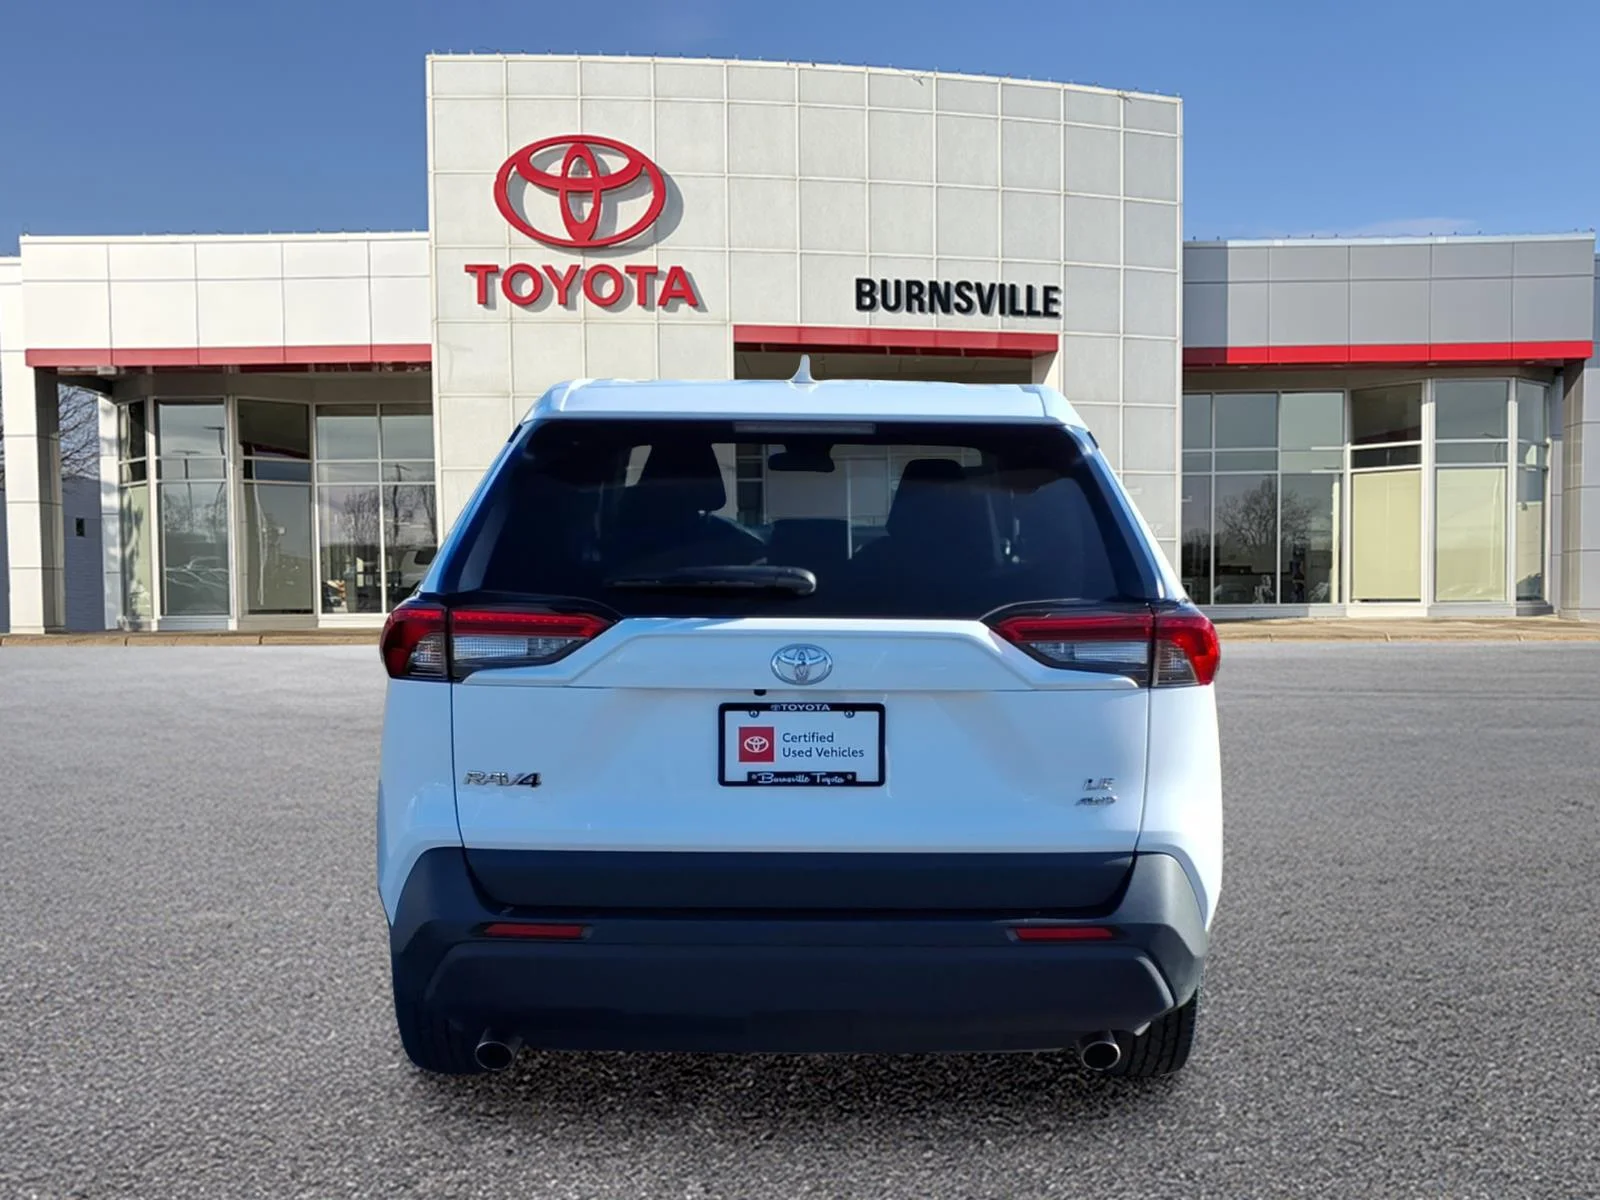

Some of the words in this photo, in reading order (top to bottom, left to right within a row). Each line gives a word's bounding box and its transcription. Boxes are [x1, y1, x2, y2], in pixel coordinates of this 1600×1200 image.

[464, 263, 699, 308] TOYOTA
[855, 277, 1062, 318] BURNSVILLE
[780, 703, 831, 711] TOYOTA
[782, 732, 834, 743] Certified
[782, 747, 812, 758] Used
[815, 746, 865, 758] Vehicles
[463, 770, 542, 788] RAV4
[811, 772, 845, 785] Toyota
[1083, 777, 1115, 791] LE
